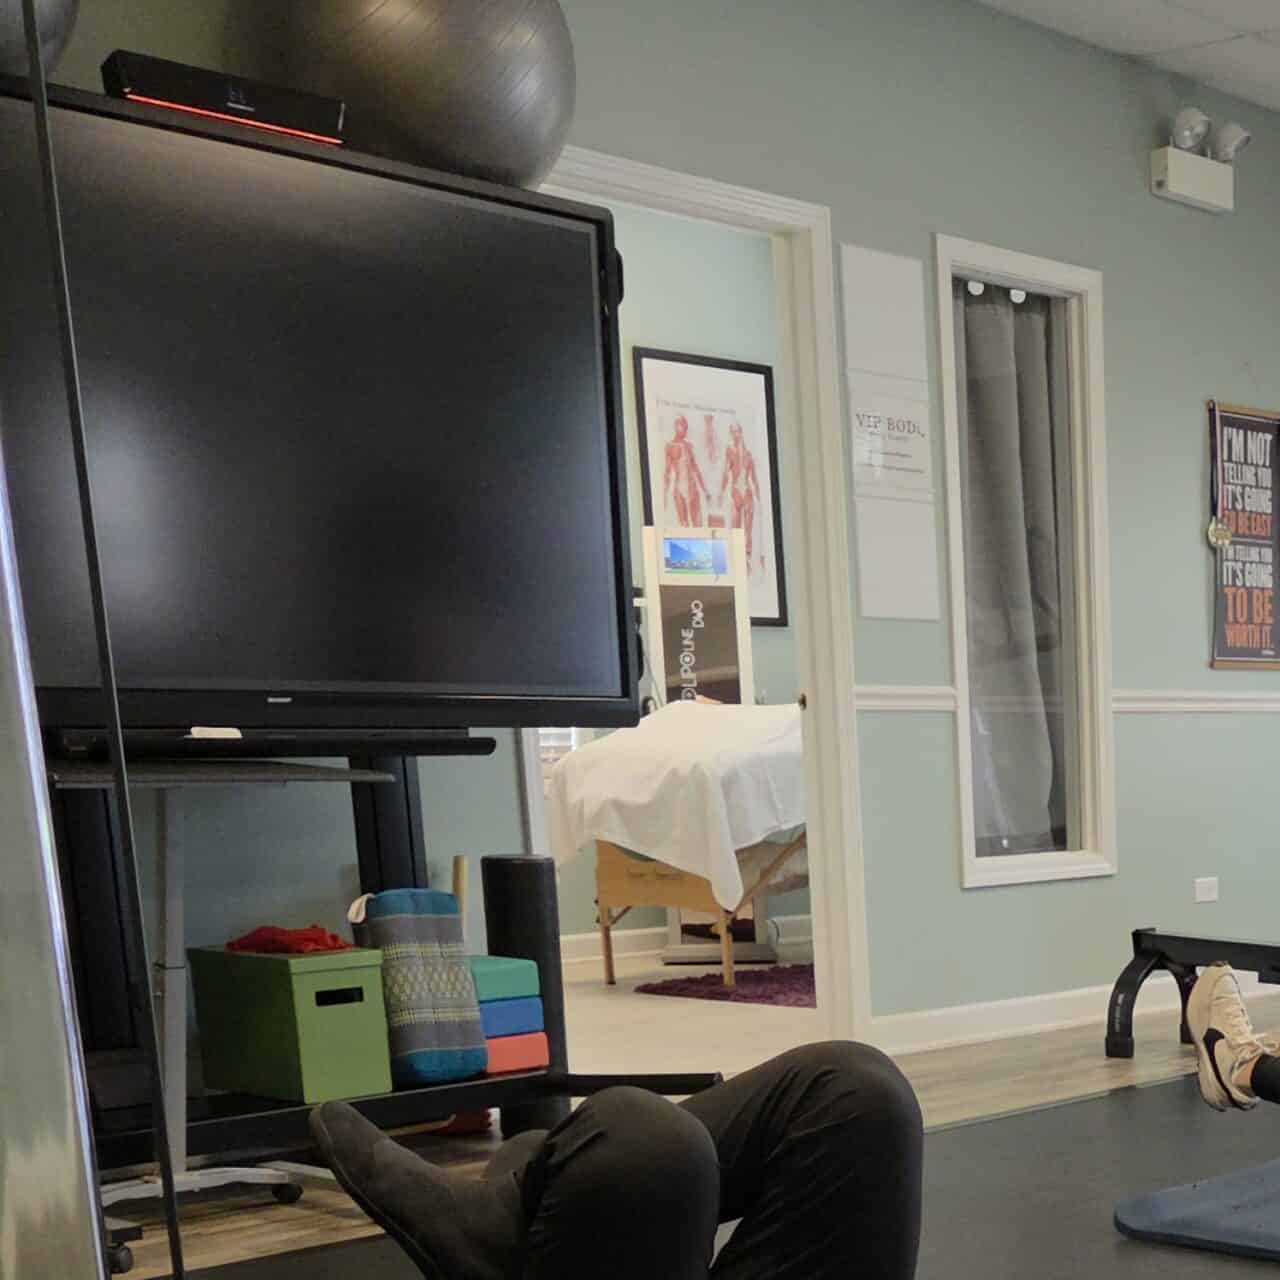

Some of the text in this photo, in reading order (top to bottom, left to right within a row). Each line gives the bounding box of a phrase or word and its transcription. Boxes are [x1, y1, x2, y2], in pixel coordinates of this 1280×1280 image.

[856, 413, 881, 431] VIP
[1223, 426, 1272, 466] I'M NOT
[1223, 462, 1272, 488] TELLING YOU
[1223, 485, 1272, 513] IT'S GOING
[1238, 512, 1248, 535] BE
[1223, 561, 1243, 587] IT'S
[1224, 587, 1273, 625] TO BE
[1225, 624, 1257, 648] WORTH
